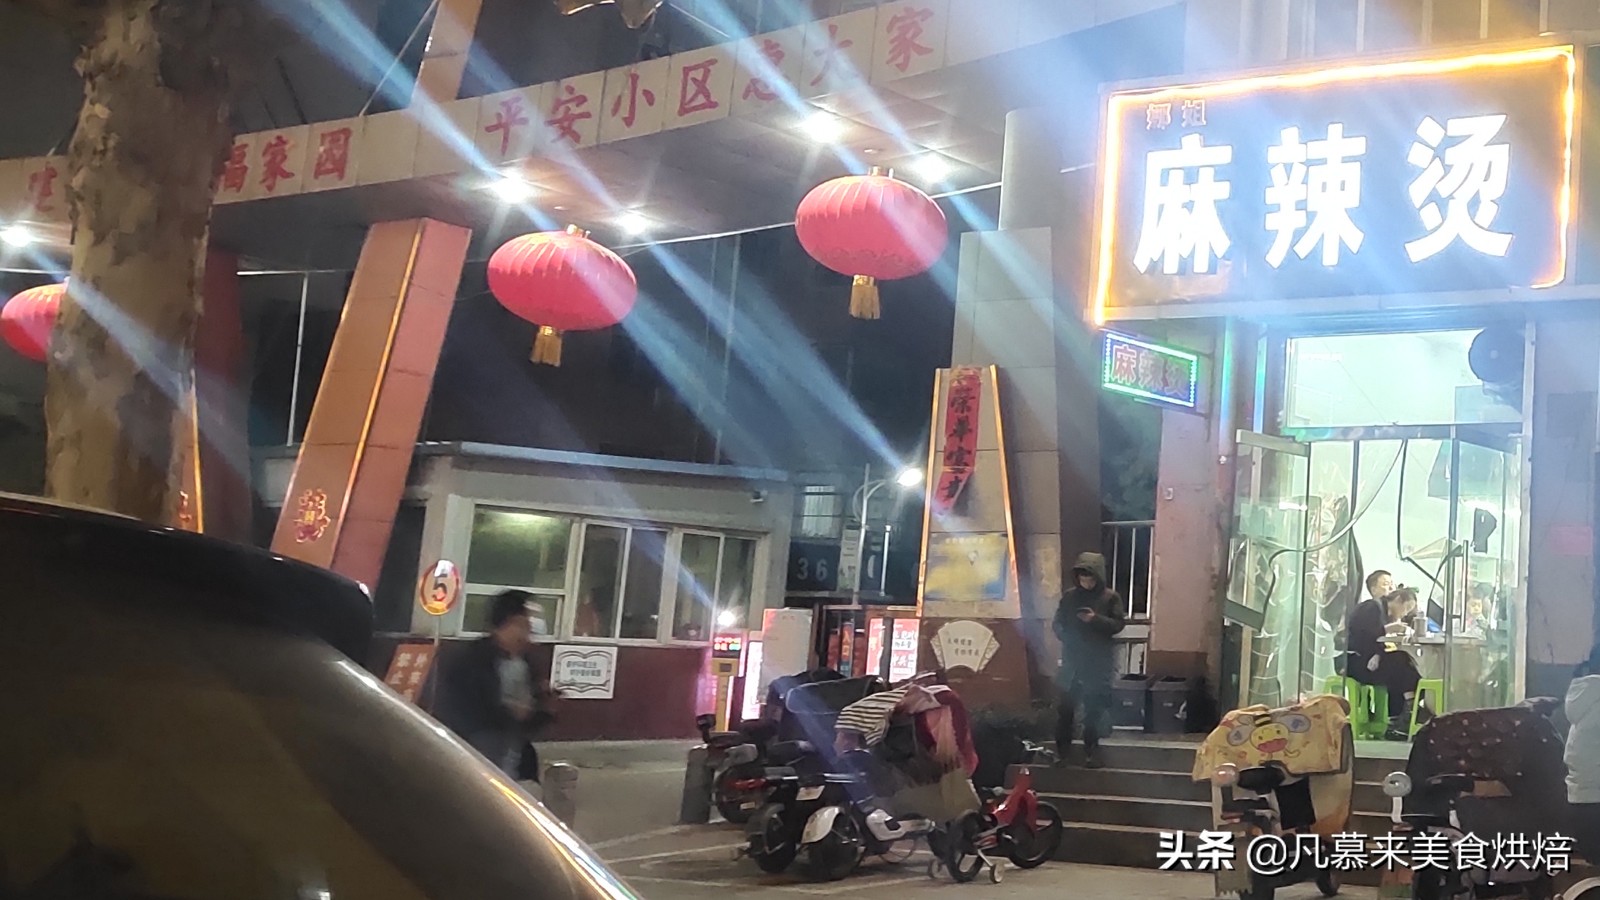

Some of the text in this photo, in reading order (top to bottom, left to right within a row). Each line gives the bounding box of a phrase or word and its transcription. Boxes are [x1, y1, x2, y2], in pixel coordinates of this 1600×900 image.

[1133, 114, 1514, 275] 麻辣烫
[432, 572, 447, 600] 5
